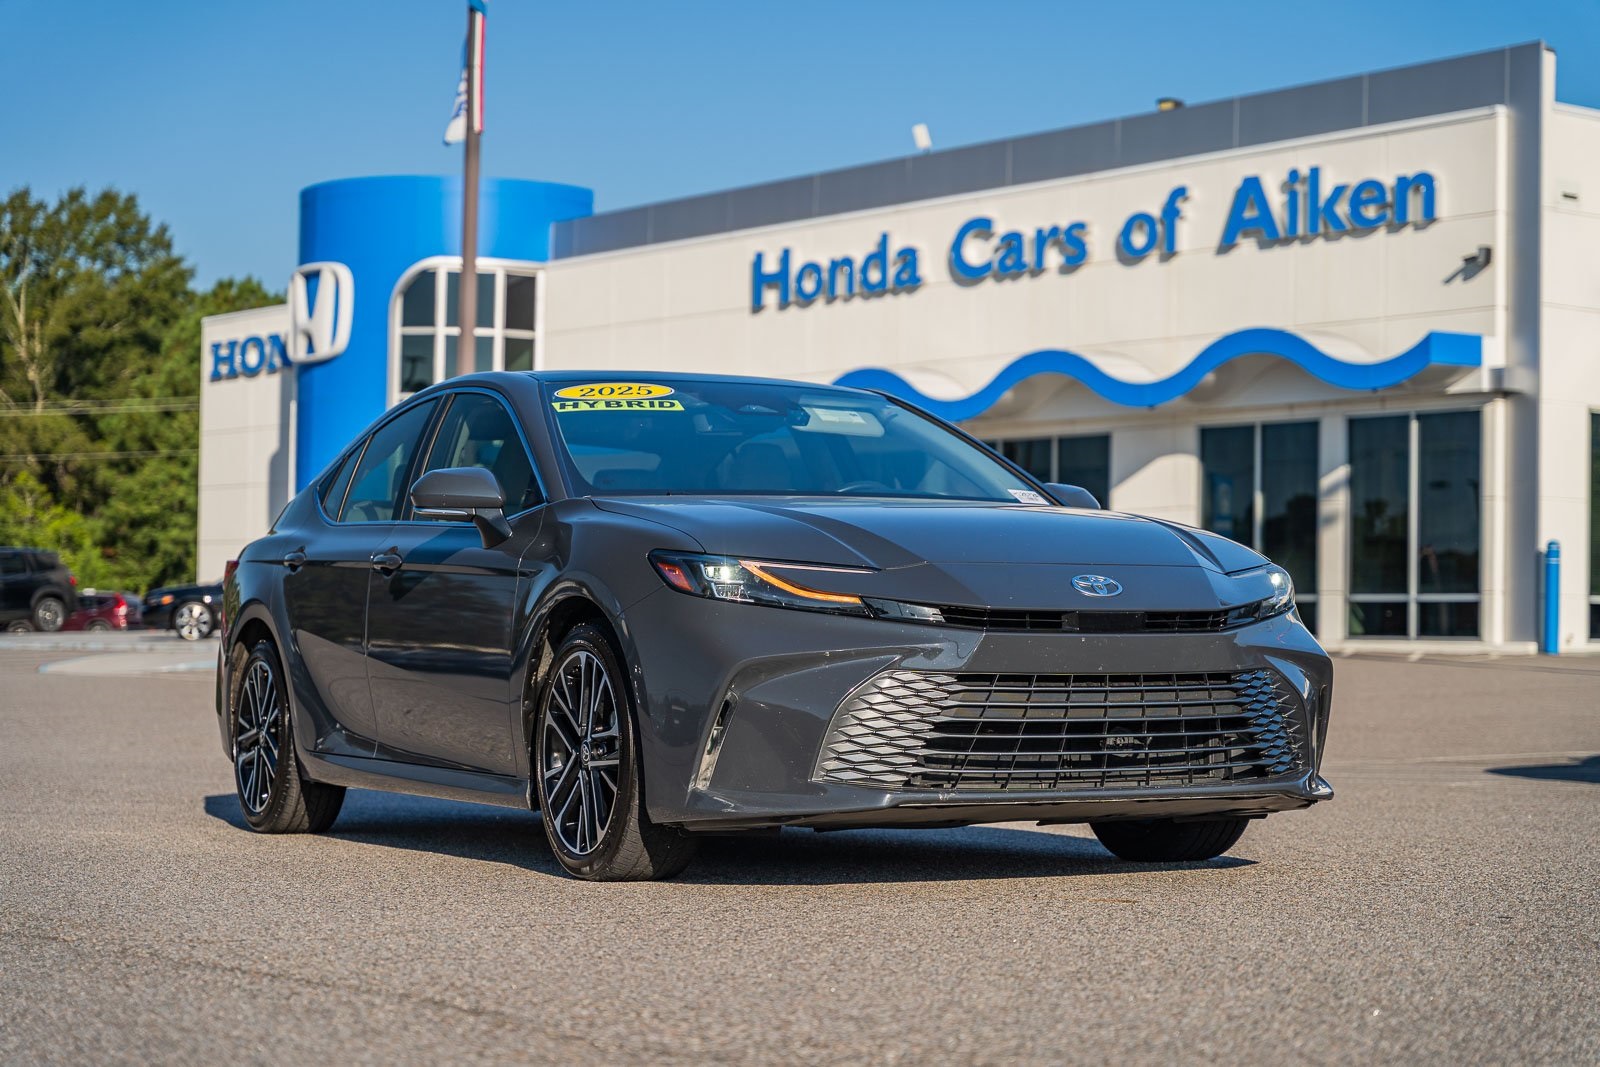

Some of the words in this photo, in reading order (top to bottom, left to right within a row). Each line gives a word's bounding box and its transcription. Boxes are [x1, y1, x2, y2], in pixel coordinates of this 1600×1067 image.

[753, 232, 922, 309] Honda
[951, 217, 1088, 281] Cars
[1120, 186, 1189, 258] of
[1222, 167, 1436, 248] Aiken
[579, 385, 653, 398] 2025
[559, 400, 676, 410] HYBRID
